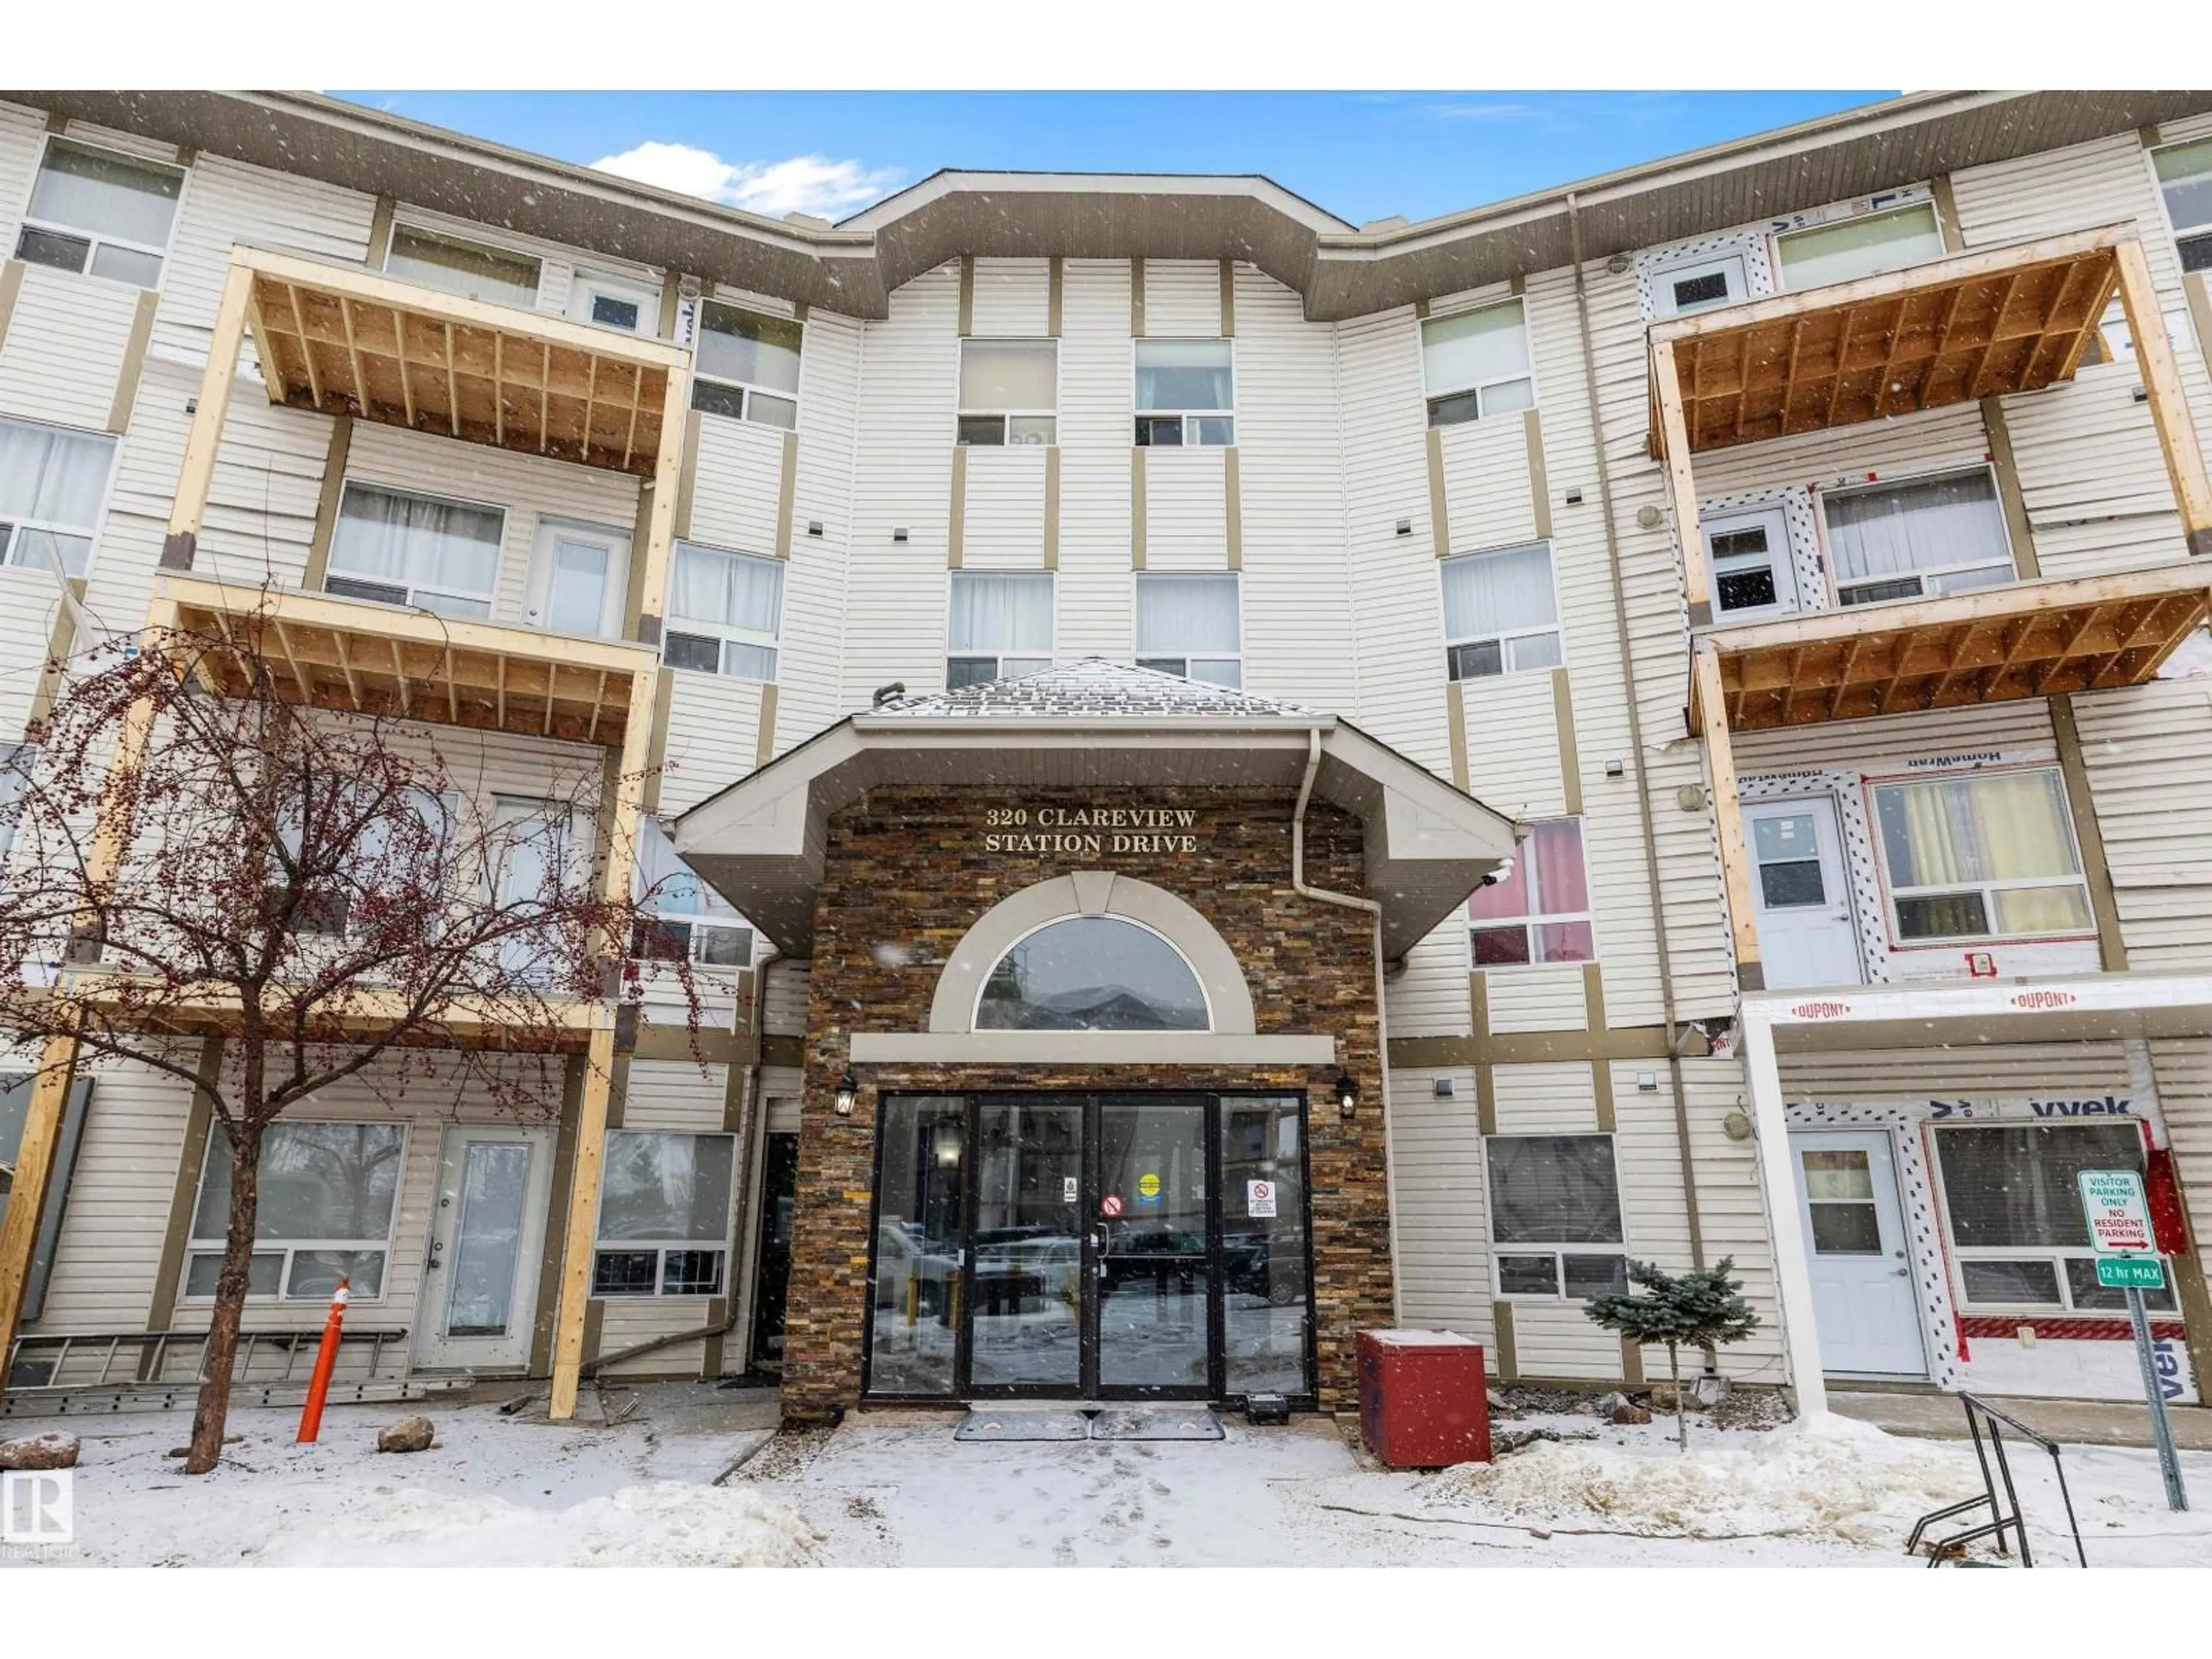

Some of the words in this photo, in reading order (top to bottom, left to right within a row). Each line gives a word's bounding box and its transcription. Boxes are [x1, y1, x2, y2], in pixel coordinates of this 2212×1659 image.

[986, 808, 1028, 825] 320
[1037, 808, 1196, 827] CLAREVIEW
[985, 834, 1101, 852] STATION
[1112, 835, 1197, 853] DRIVE
[2017, 991, 2068, 1009] DUPONT
[1798, 1002, 1844, 1018] DUPONT
[2089, 1177, 2131, 1187] VISITOR
[2089, 1187, 2135, 1196] PARKING
[2101, 1198, 2128, 1207] ONLY
[2108, 1209, 2124, 1218] NO
[2094, 1219, 2144, 1228] RESIDENT
[2099, 1229, 2145, 1238] PARKING
[2100, 1267, 2113, 1279] 12
[2115, 1267, 2128, 1279] hr
[2133, 1267, 2161, 1280] MAX
